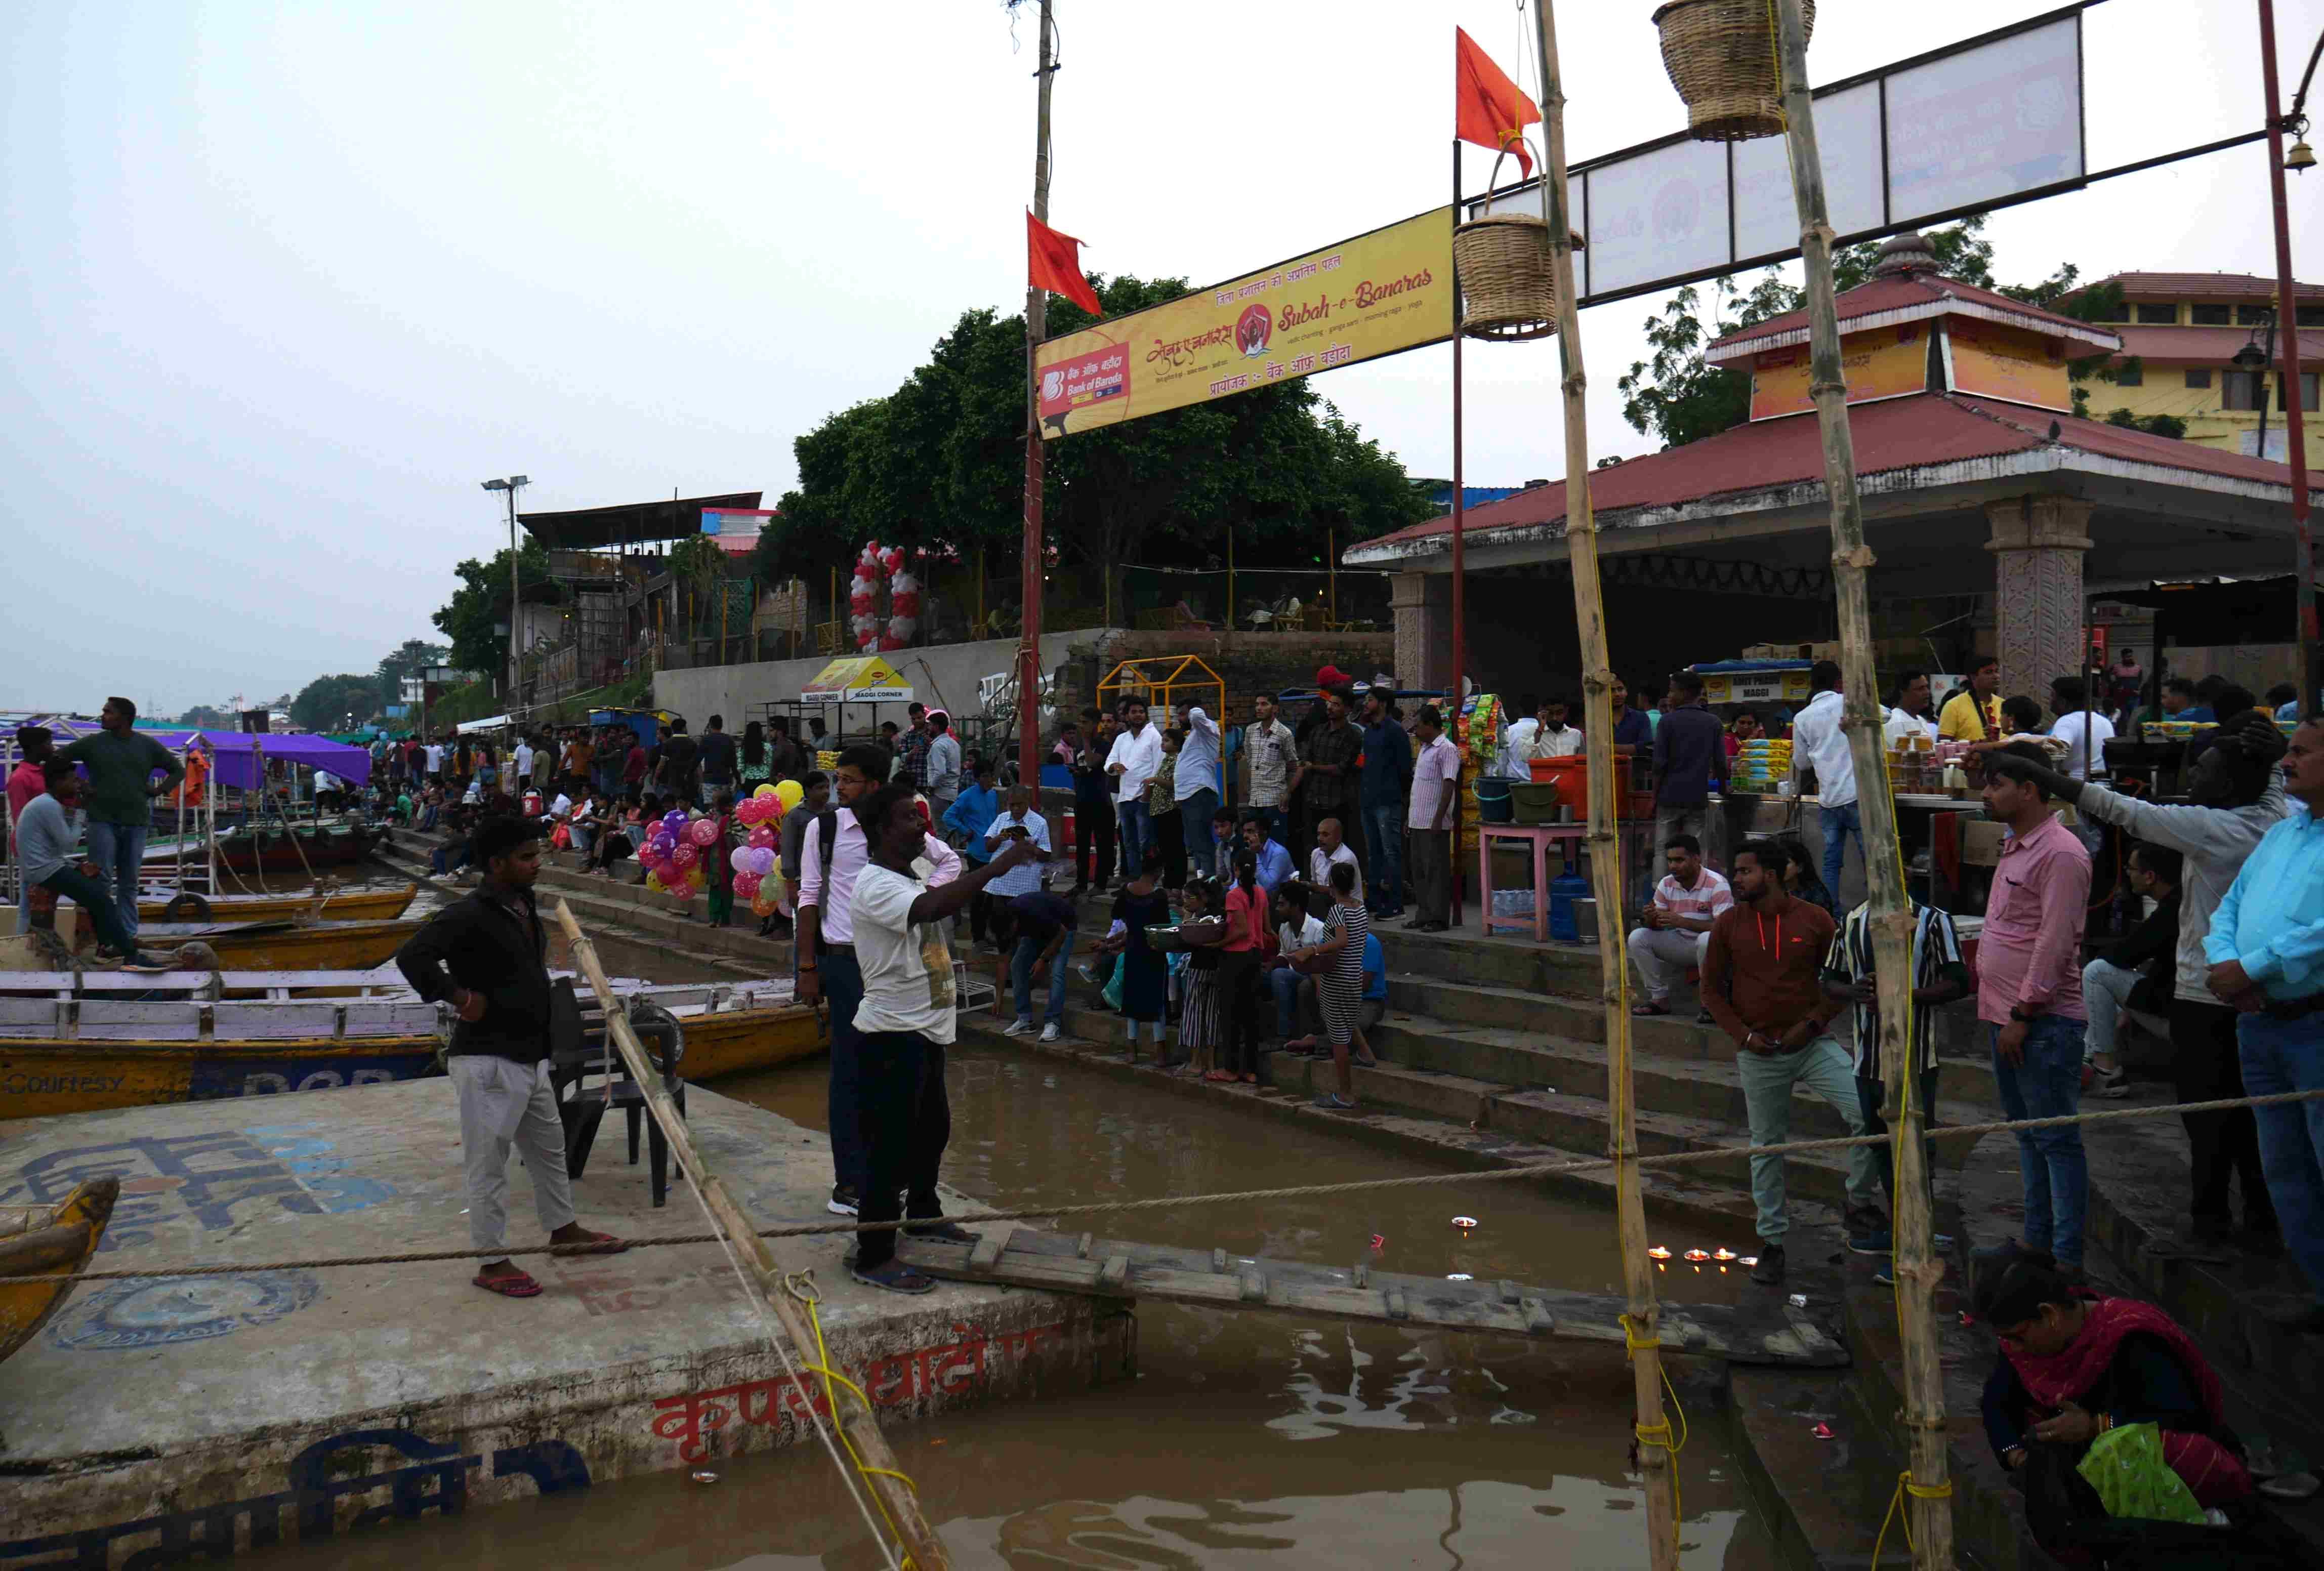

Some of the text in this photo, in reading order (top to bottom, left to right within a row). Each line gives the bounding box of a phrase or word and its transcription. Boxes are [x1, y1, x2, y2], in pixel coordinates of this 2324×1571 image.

[1216, 255, 1341, 307] जिला प्रशासन की अप्रतिम पहल
[1266, 361, 1284, 379] बैंक
[1067, 382, 1086, 396] Bank
[1087, 379, 1094, 391] of
[1095, 373, 1123, 389] Baroda
[1743, 688, 1770, 697] MAGGI
